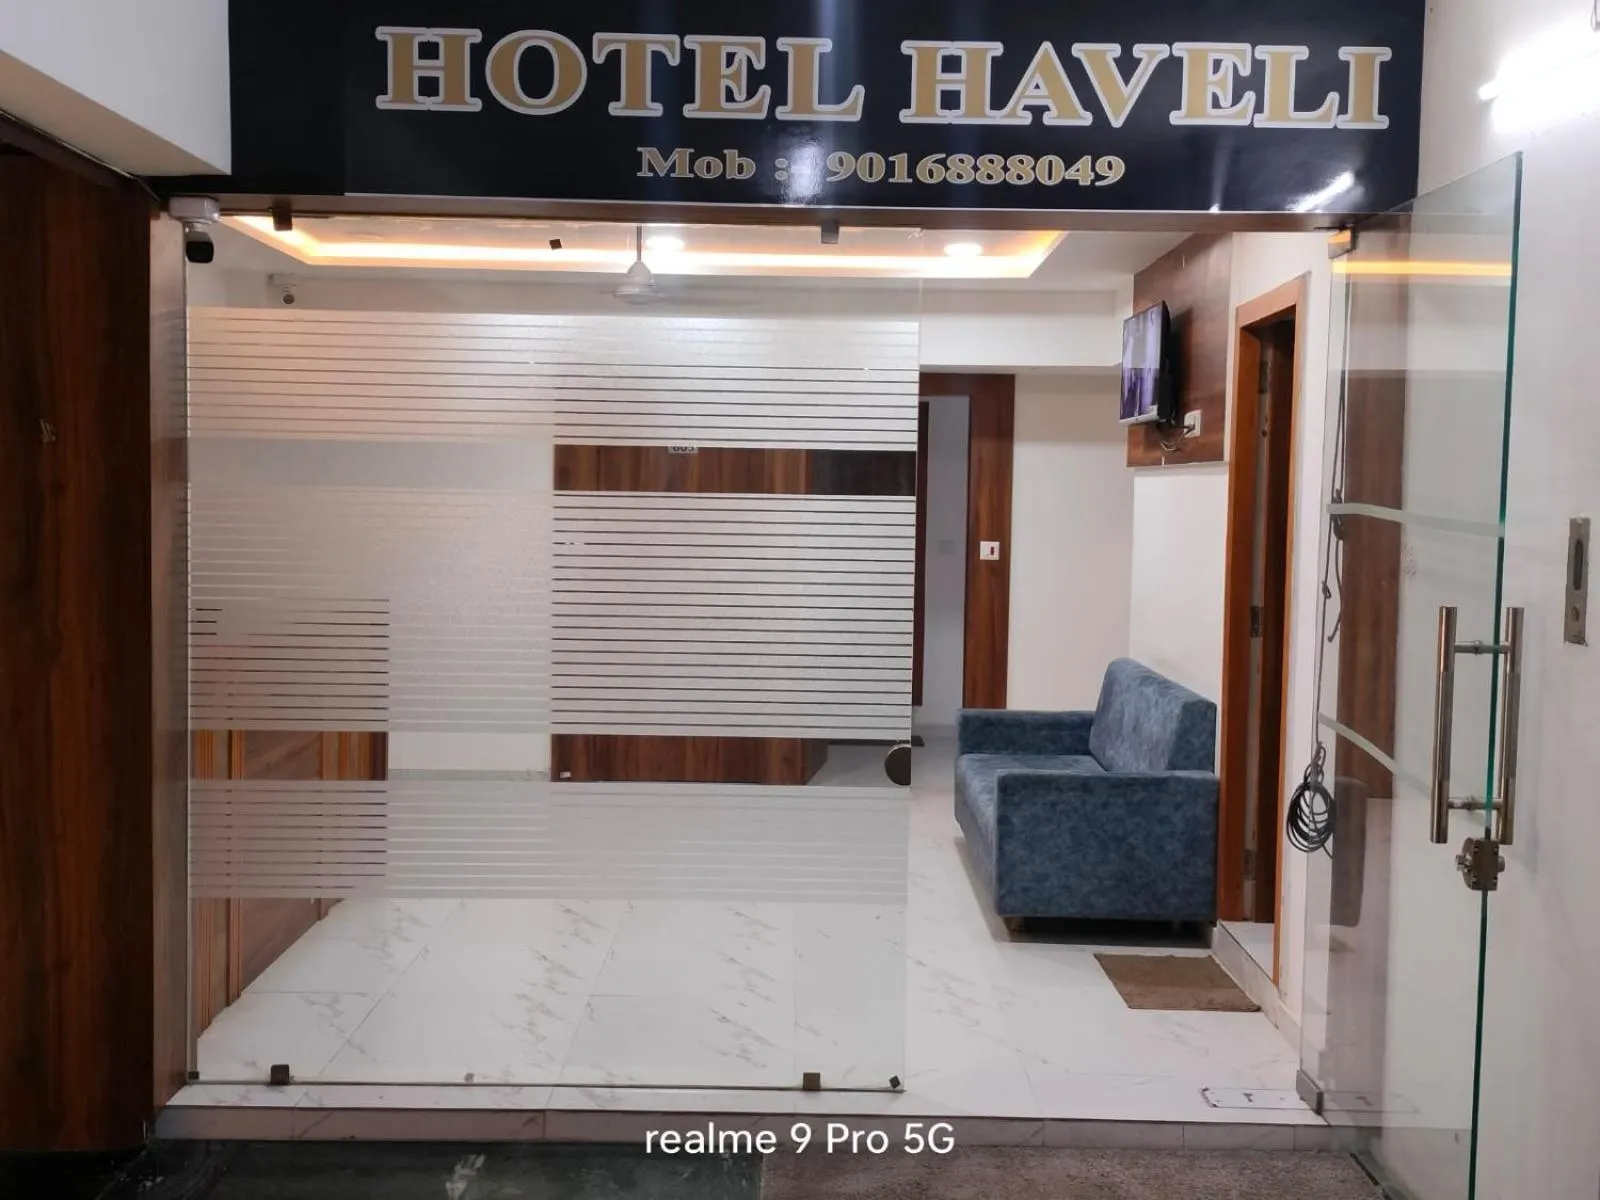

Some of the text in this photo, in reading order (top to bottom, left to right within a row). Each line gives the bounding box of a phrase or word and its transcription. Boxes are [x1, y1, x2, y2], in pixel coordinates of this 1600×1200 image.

[375, 26, 1393, 129] HOTEL HAVELI
[636, 146, 1126, 187] Mob : 9016888049
